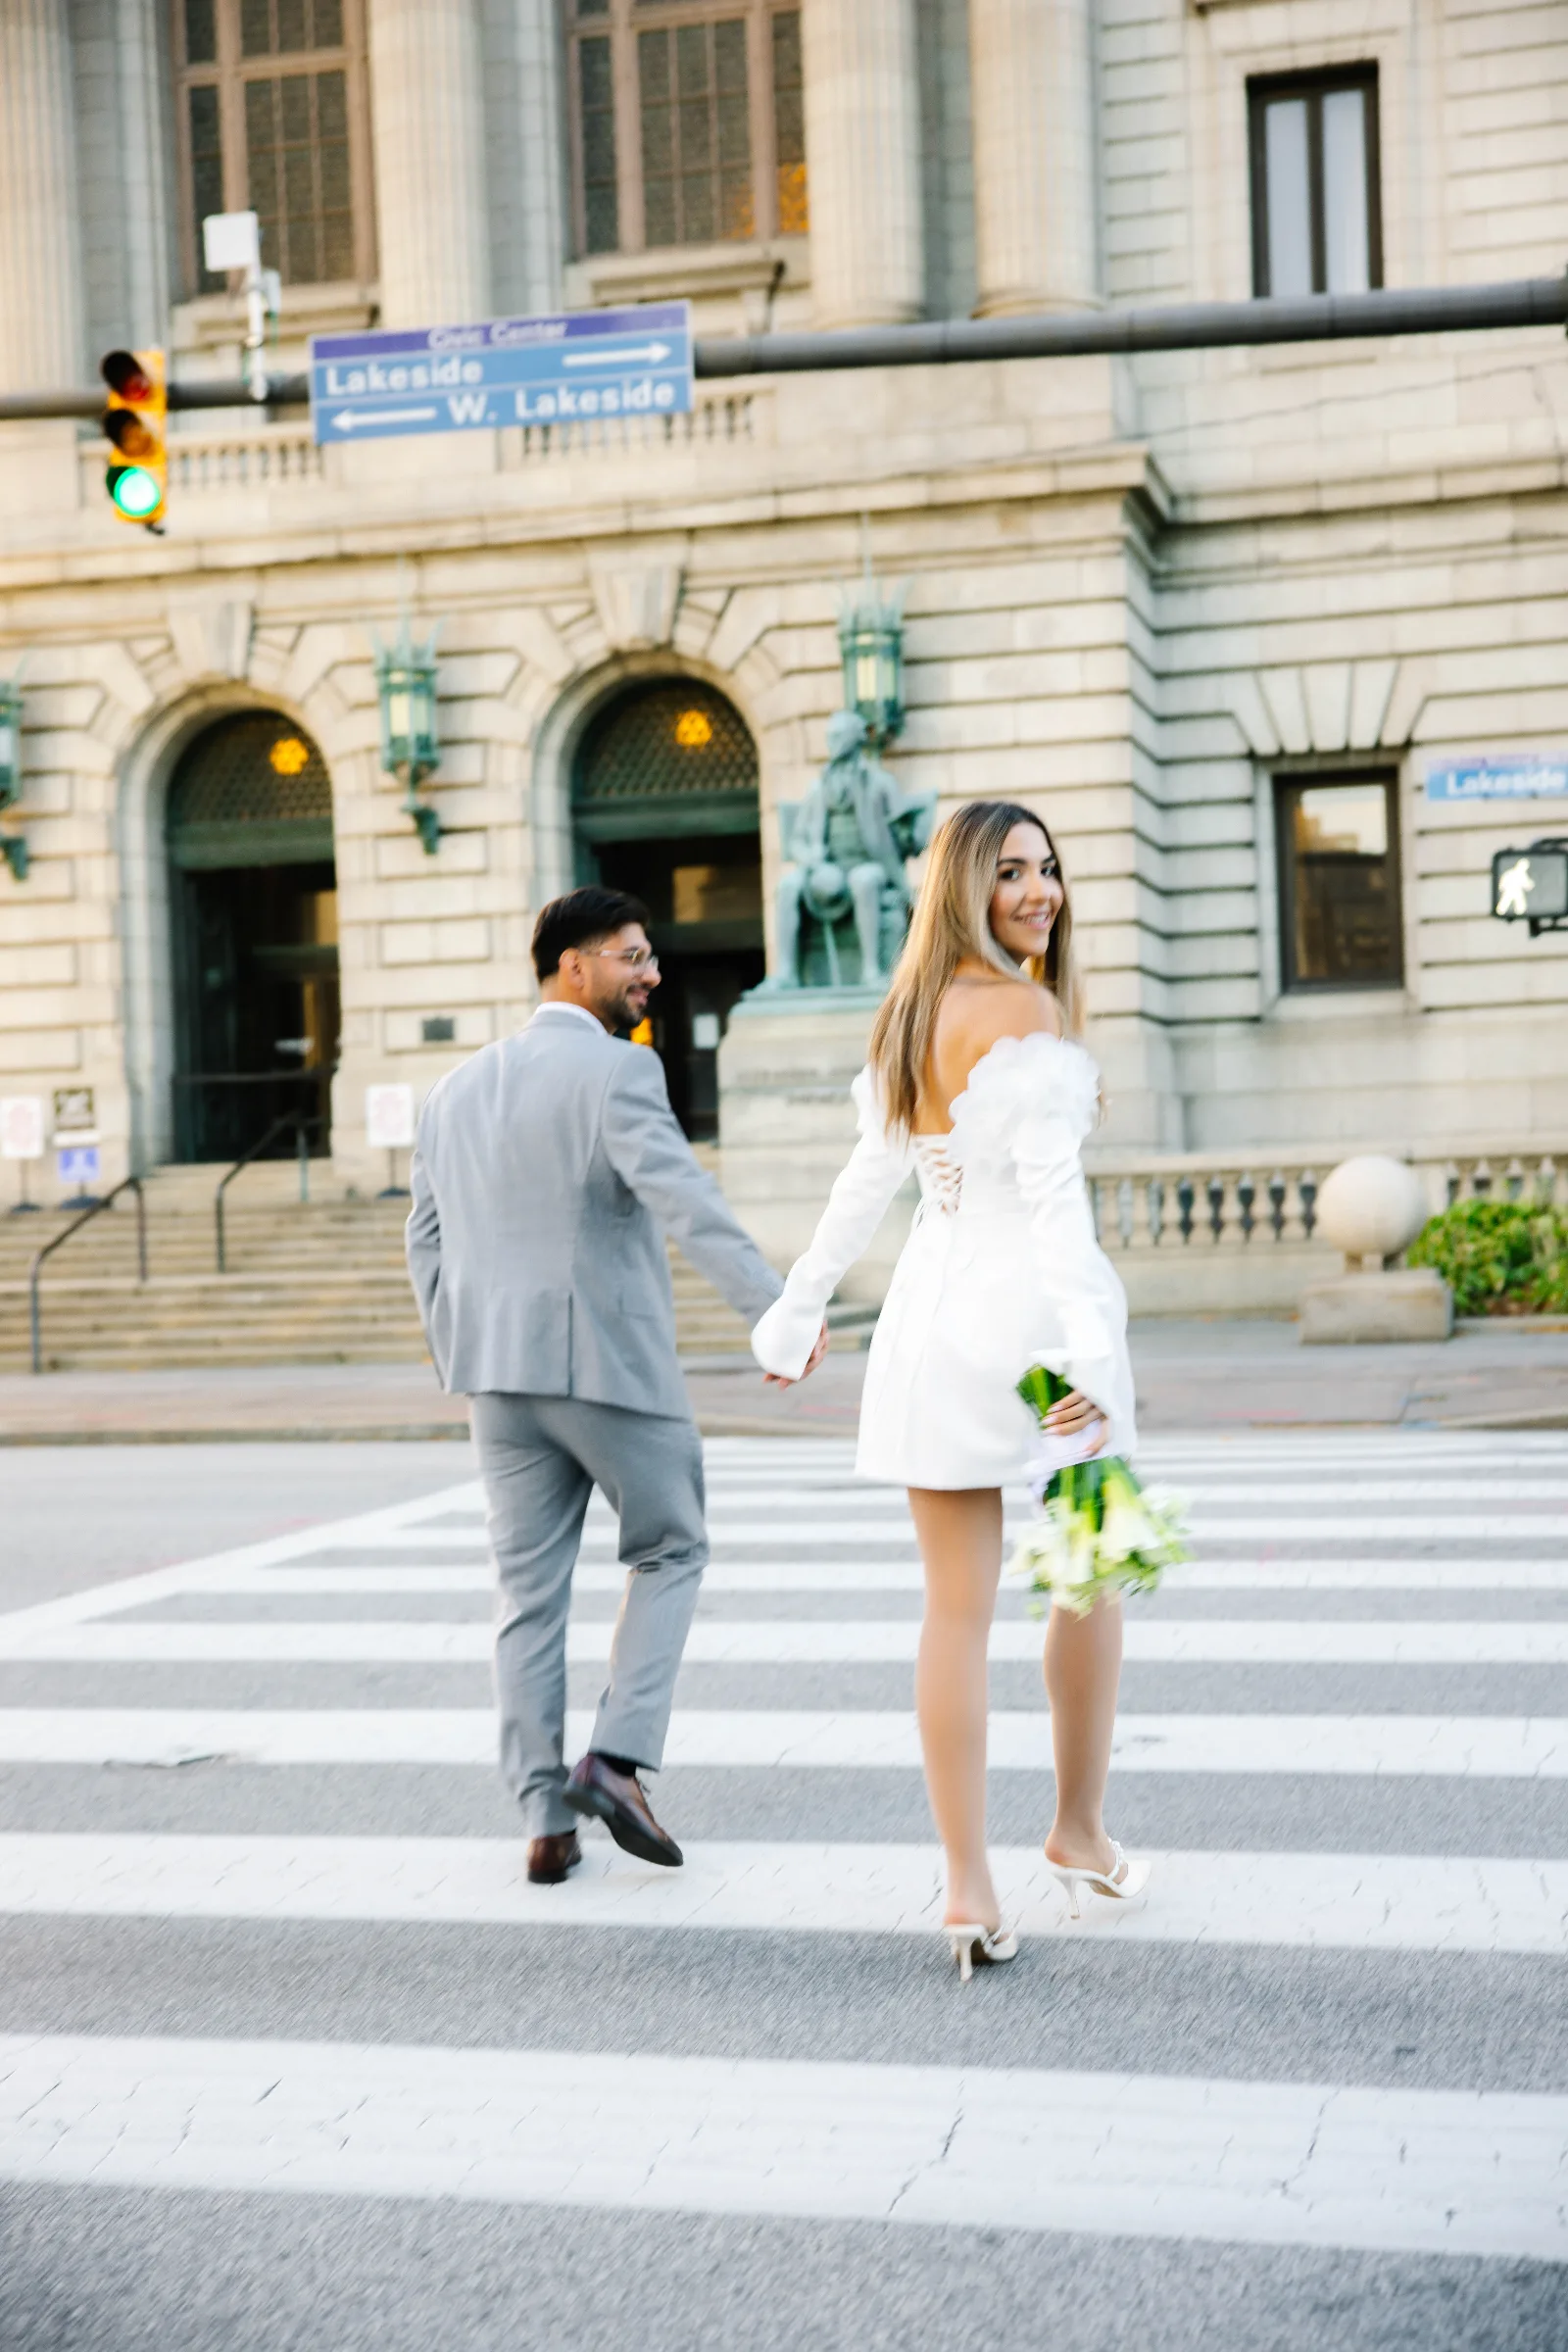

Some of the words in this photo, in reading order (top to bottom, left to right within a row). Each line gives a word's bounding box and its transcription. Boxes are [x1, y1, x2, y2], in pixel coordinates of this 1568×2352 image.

[428, 328, 482, 349] Civic
[490, 321, 567, 345] Center
[325, 357, 483, 395] Lakeside
[448, 393, 497, 424] W.
[514, 379, 675, 418] Lakeside
[1446, 766, 1566, 796] Lakeside
